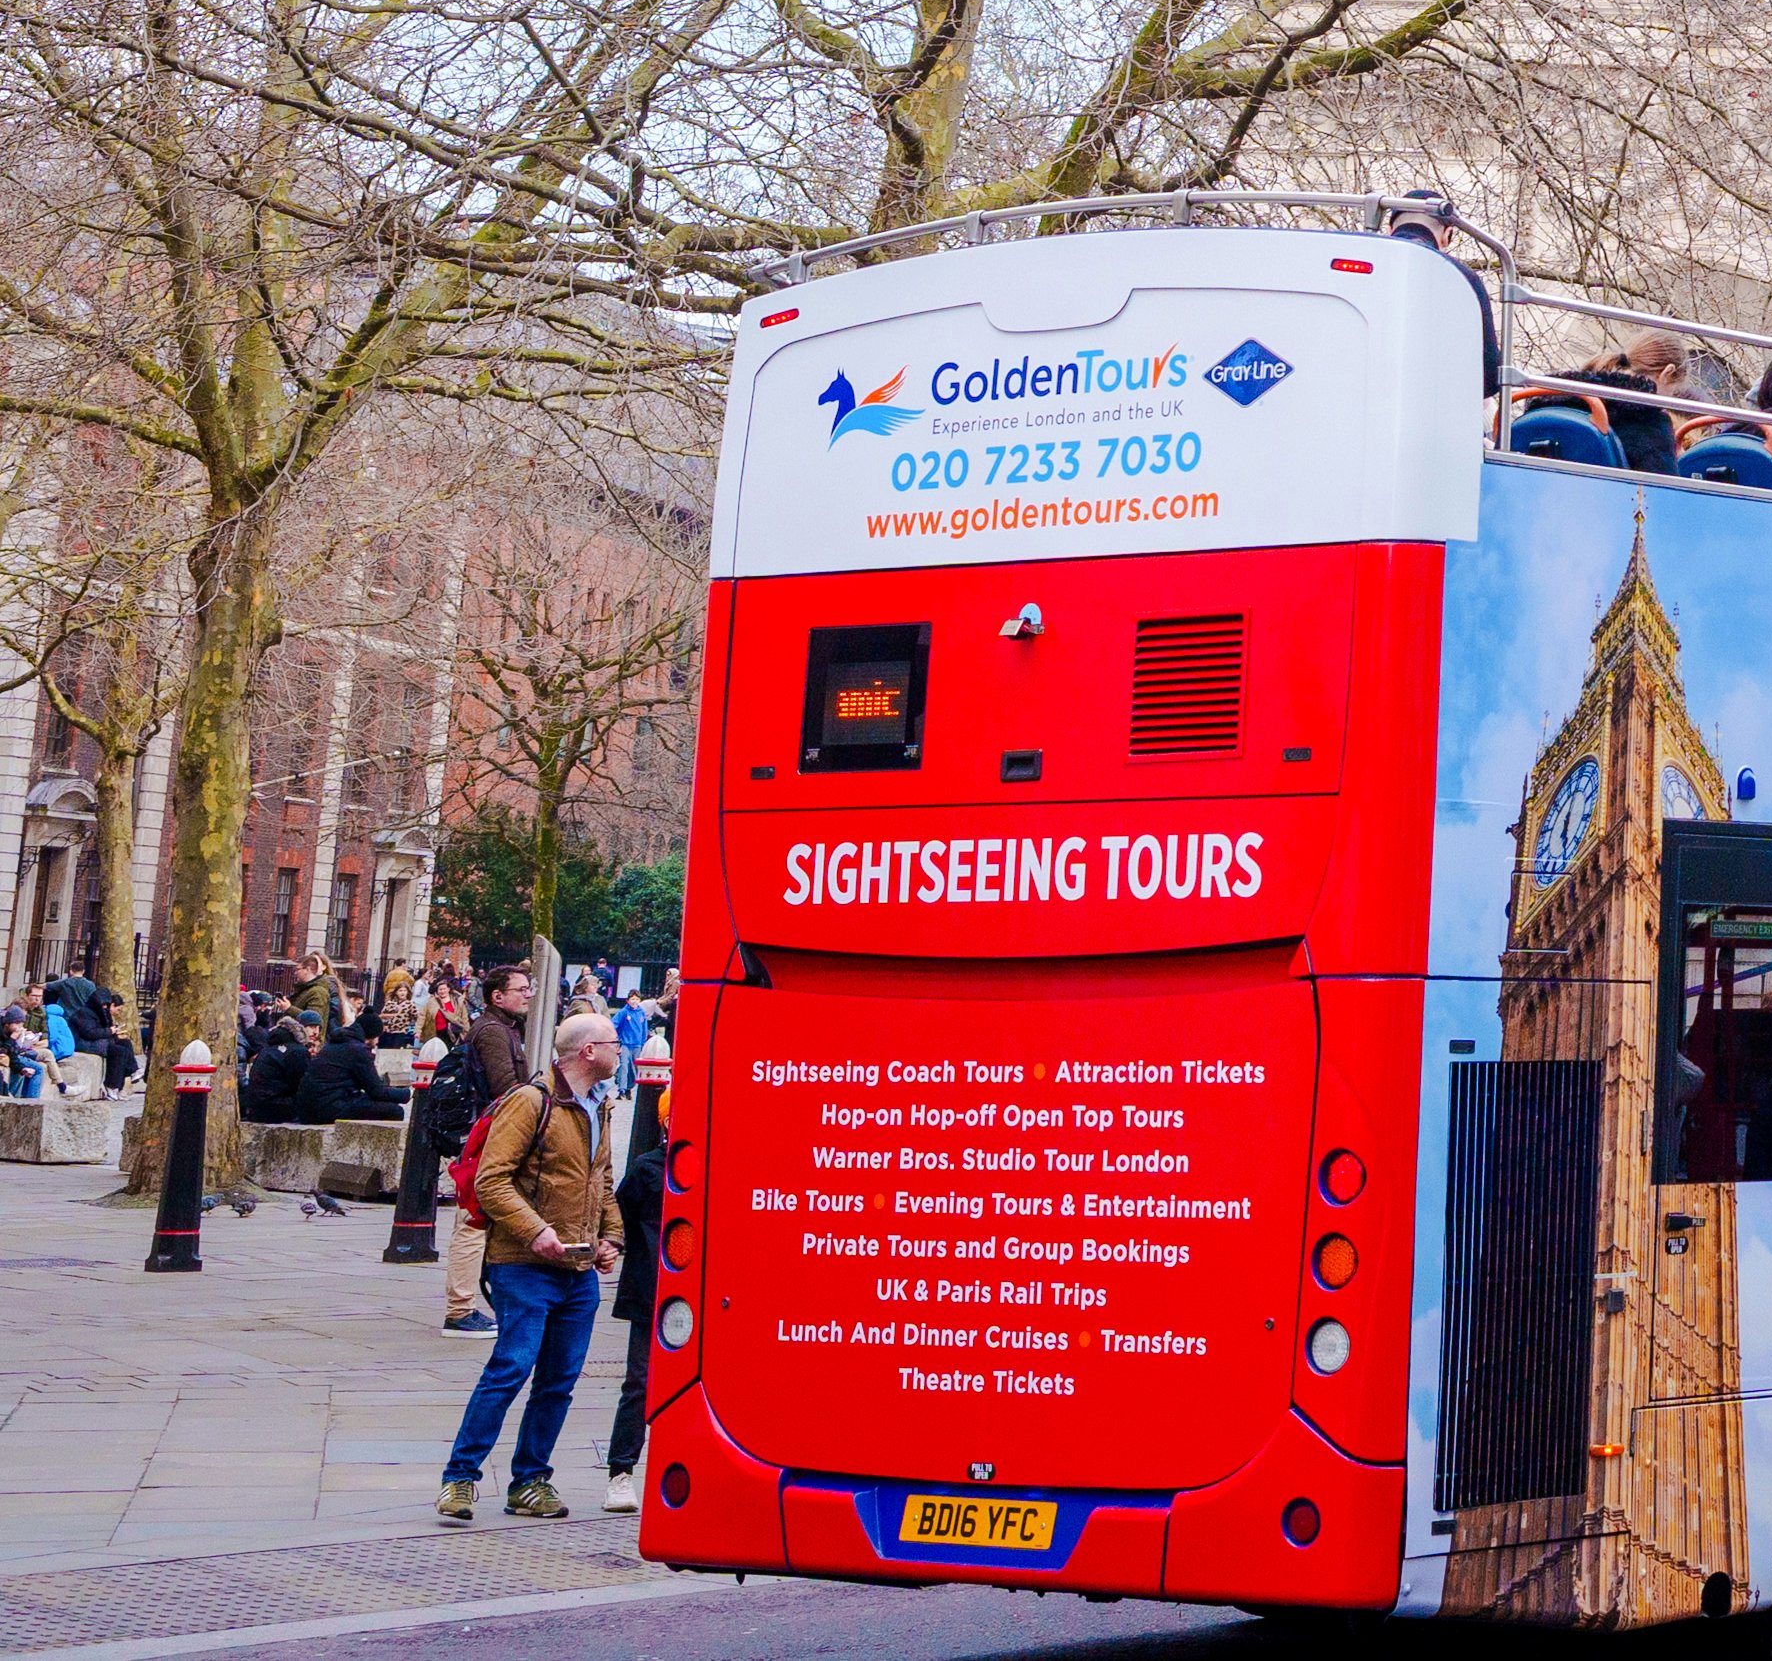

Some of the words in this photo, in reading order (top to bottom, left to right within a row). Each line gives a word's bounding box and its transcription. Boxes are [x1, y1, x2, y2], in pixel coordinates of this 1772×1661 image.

[931, 342, 1187, 406] GoldenTours
[932, 414, 1019, 439] Experience
[1026, 408, 1086, 427] London
[1093, 405, 1121, 423] and
[1128, 402, 1154, 420] the
[1161, 400, 1183, 417] UK
[891, 449, 969, 492] 020
[985, 441, 1081, 485] 7233
[1097, 432, 1201, 478] 7030
[867, 492, 1219, 539] www.goldentours.com
[783, 837, 1086, 905] SIGHTSEEING
[1101, 832, 1263, 899] TOURS
[1713, 923, 1757, 935] EMERGENCY
[752, 1060, 879, 1086] Sightseeing
[887, 1060, 955, 1082] Coach
[964, 1061, 1023, 1083] Tours
[1055, 1060, 1172, 1083] Attraction
[1182, 1060, 1265, 1083] Tickets
[822, 1104, 902, 1129] Hop-on
[911, 1104, 996, 1130] Hop-off
[1004, 1105, 1063, 1131] Open
[1072, 1105, 1113, 1131] Top
[1122, 1106, 1183, 1128] Tours
[813, 1147, 892, 1169] Warner
[900, 1148, 954, 1169] Bros.
[962, 1148, 1035, 1171] Studio
[1044, 1149, 1094, 1171] Tour
[1102, 1150, 1188, 1173] London
[752, 1189, 798, 1211] Bike
[806, 1190, 864, 1212] Tours
[895, 1192, 983, 1218] Evening
[992, 1193, 1052, 1215] Tours
[1061, 1194, 1075, 1215] &
[1084, 1194, 1251, 1219] Entertainment
[803, 1233, 879, 1256] Private
[887, 1234, 946, 1257] Tours
[955, 1236, 995, 1258] and
[1004, 1237, 1073, 1264] Group
[1082, 1239, 1189, 1267] Bookings
[877, 1279, 908, 1300] UK
[914, 1280, 928, 1301] &
[937, 1280, 991, 1303] Paris
[1000, 1282, 1042, 1304] Rail
[1051, 1283, 1106, 1310] Trips
[778, 1320, 842, 1342] Lunch
[850, 1322, 895, 1344] And
[904, 1323, 977, 1347] Dinner
[986, 1326, 1068, 1350] Cruises
[1101, 1330, 1206, 1355] Transfers
[899, 1367, 984, 1392] Theatre
[993, 1370, 1074, 1395] Tickets
[917, 1502, 978, 1537] BD16
[988, 1505, 1038, 1541] YFC
